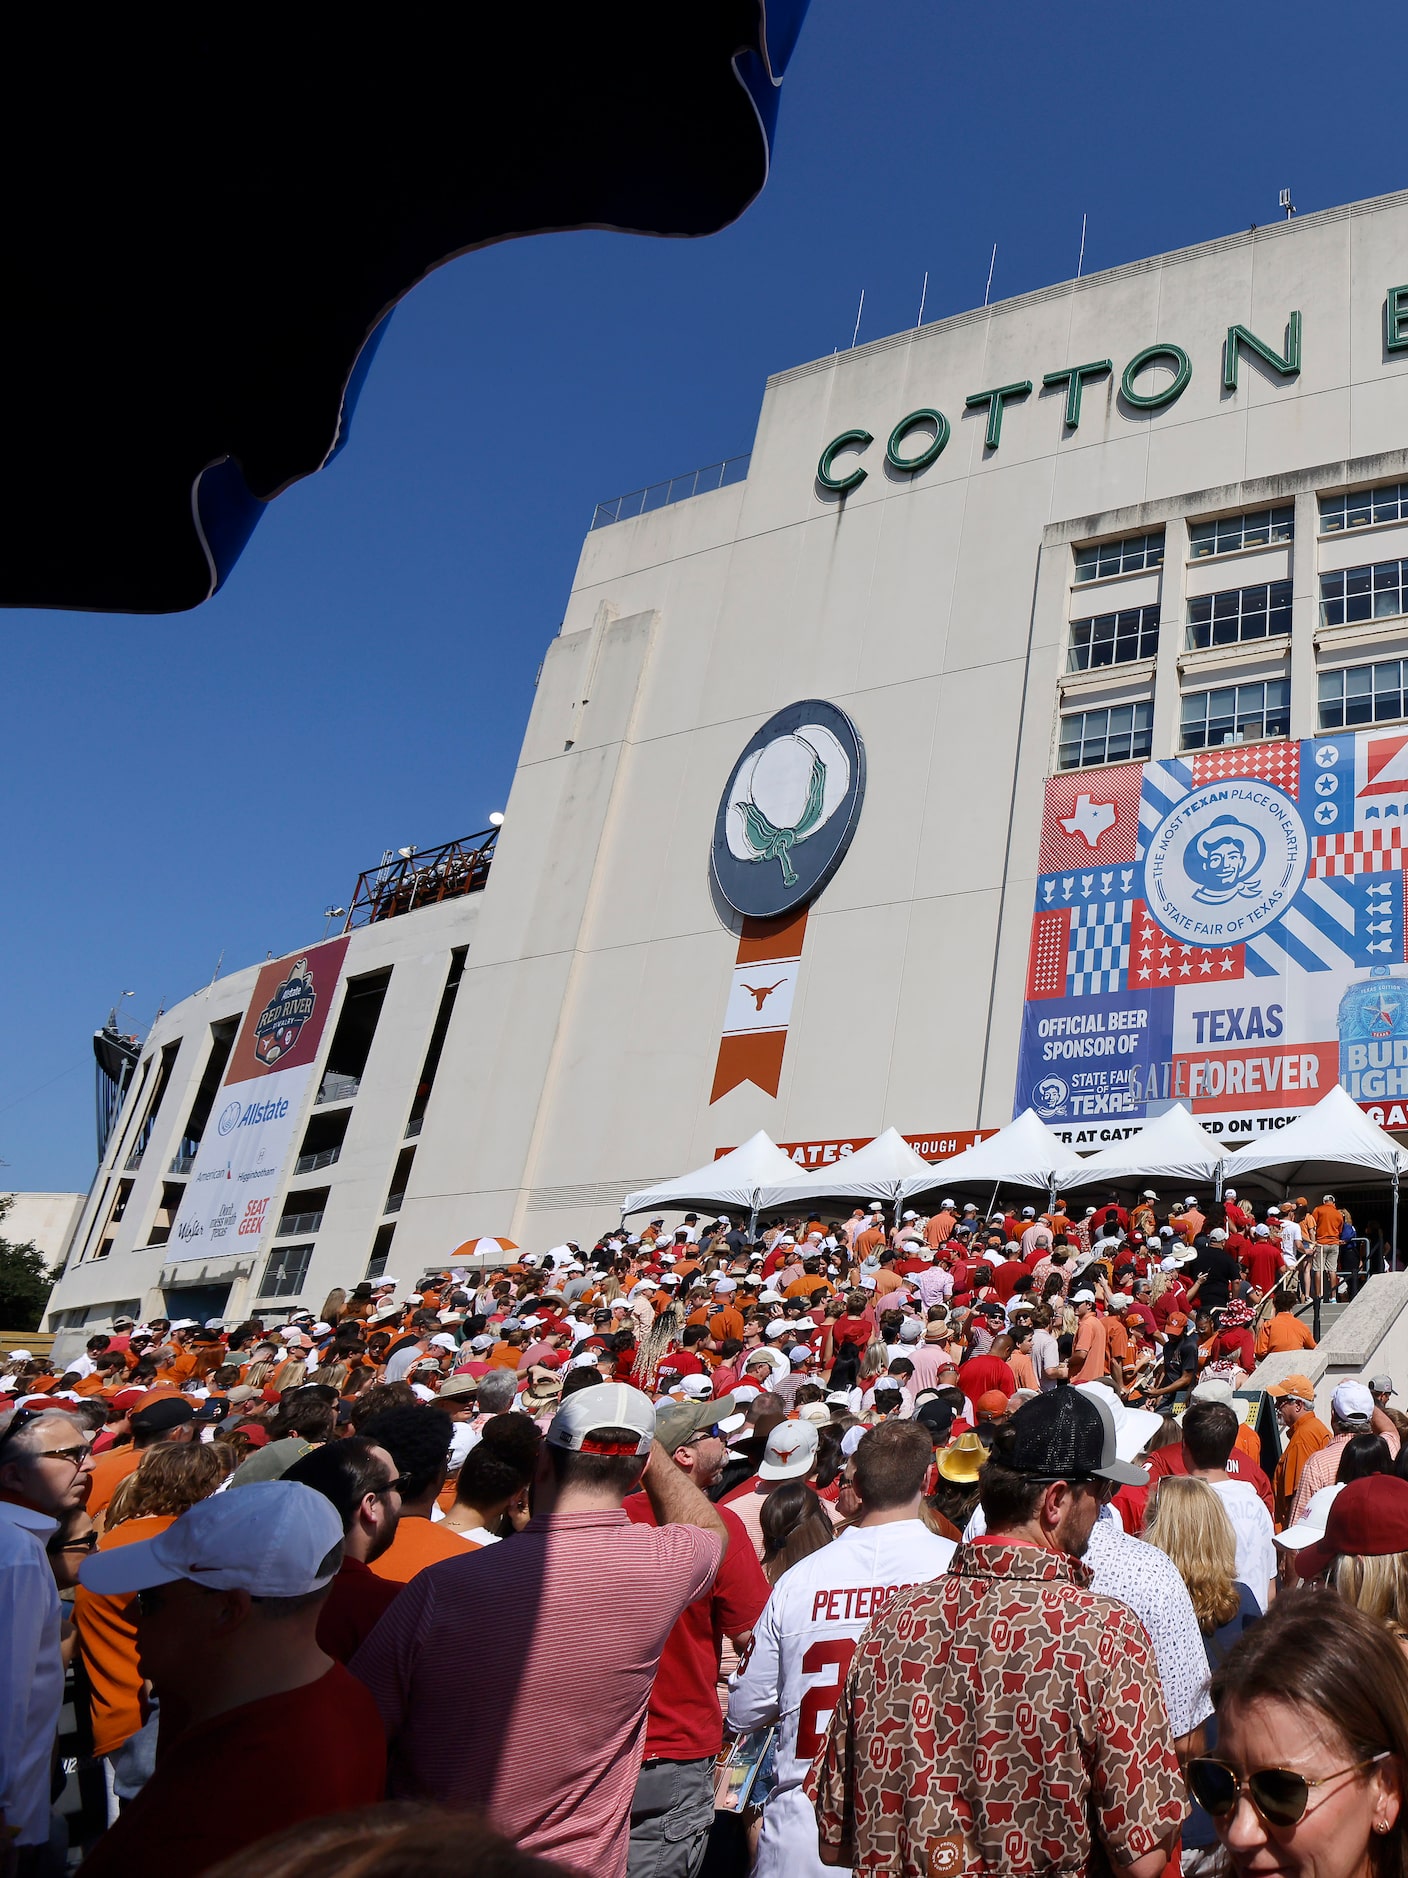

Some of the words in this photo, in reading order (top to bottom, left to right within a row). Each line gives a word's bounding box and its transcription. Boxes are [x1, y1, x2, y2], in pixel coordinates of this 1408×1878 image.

[815, 310, 1301, 492] COTTON
[1153, 853, 1165, 878] THE
[1159, 816, 1184, 851] MOST
[1182, 790, 1229, 817] TEXAN
[1231, 790, 1270, 807] PLACE
[1269, 803, 1287, 821] ON
[1282, 820, 1298, 862] EARTH
[1163, 902, 1193, 930] STATE
[1193, 922, 1222, 935] FAIR
[1227, 917, 1245, 932] OF
[1246, 890, 1283, 924] TEXAS
[259, 1006, 282, 1028] RED
[282, 998, 312, 1017] RIVER
[1038, 1013, 1105, 1037] OFFICIAL
[1107, 1009, 1148, 1031] BEER
[1192, 1003, 1283, 1044] TEXAS
[1042, 1036, 1115, 1061] SPONSOR
[1117, 1034, 1139, 1053] OF
[1071, 1072, 1107, 1087] STATE
[1128, 1060, 1187, 1100] GATE
[1189, 1054, 1319, 1097] FOREVER
[1096, 1085, 1109, 1094] OF
[237, 1097, 289, 1128] Allstate
[1070, 1092, 1135, 1116] TEXAS
[1076, 1130, 1097, 1143] AT
[1228, 1119, 1252, 1132] ON
[910, 1139, 957, 1154] ROUGH
[196, 1169, 225, 1182] American
[245, 1197, 270, 1217] SEAT
[238, 1216, 265, 1236] GEEK
